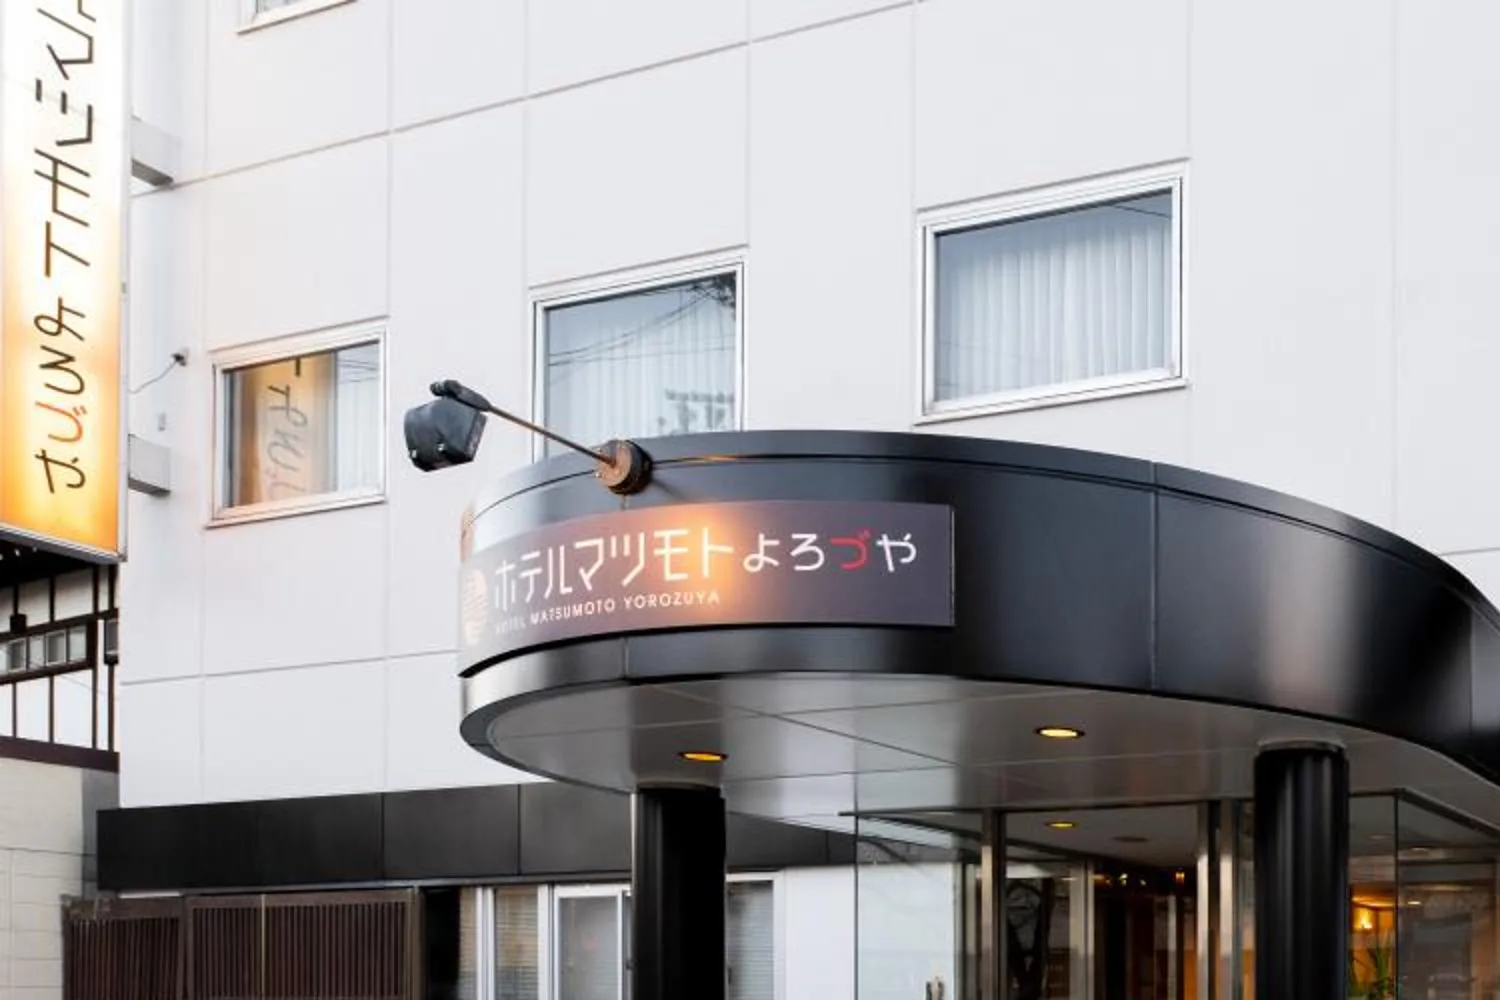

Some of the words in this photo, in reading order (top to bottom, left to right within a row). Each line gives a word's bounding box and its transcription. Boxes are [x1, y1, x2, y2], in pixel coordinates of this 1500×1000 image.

[494, 526, 918, 612] ホテルマツモトよろづや
[530, 599, 616, 626] MATSUMOTO
[623, 591, 720, 610] YOROZUYA
